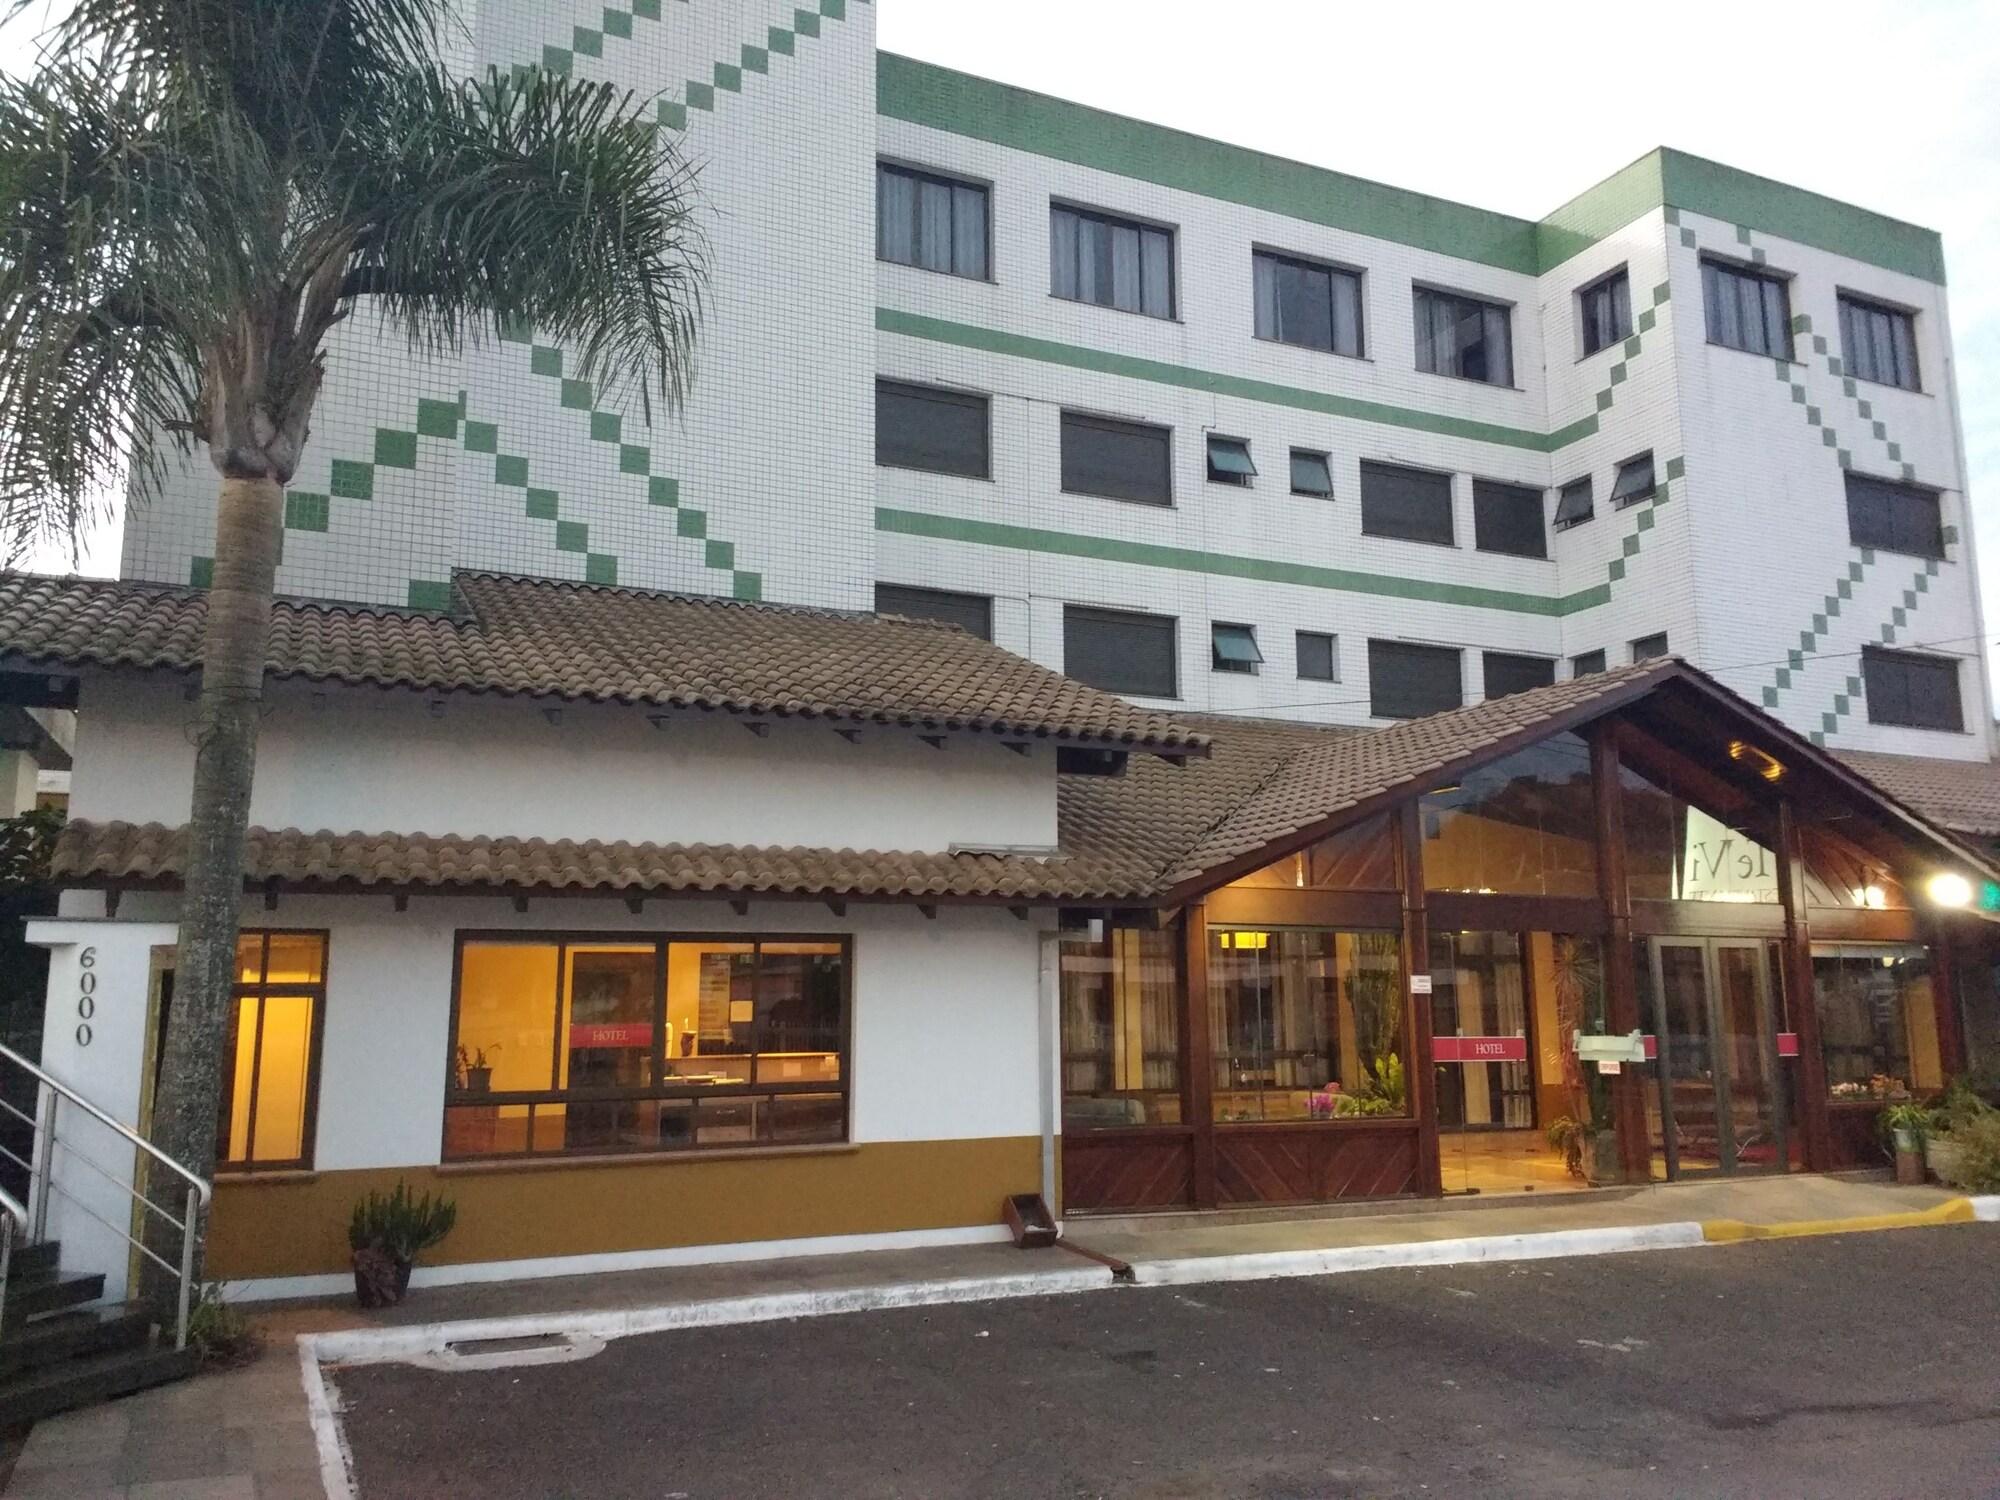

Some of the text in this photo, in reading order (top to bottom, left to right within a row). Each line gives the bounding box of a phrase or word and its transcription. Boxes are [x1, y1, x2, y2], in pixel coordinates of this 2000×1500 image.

[75, 946, 97, 1047] 6000
[592, 1029, 630, 1041] HOTEL
[1475, 1042, 1506, 1055] HOTEL
